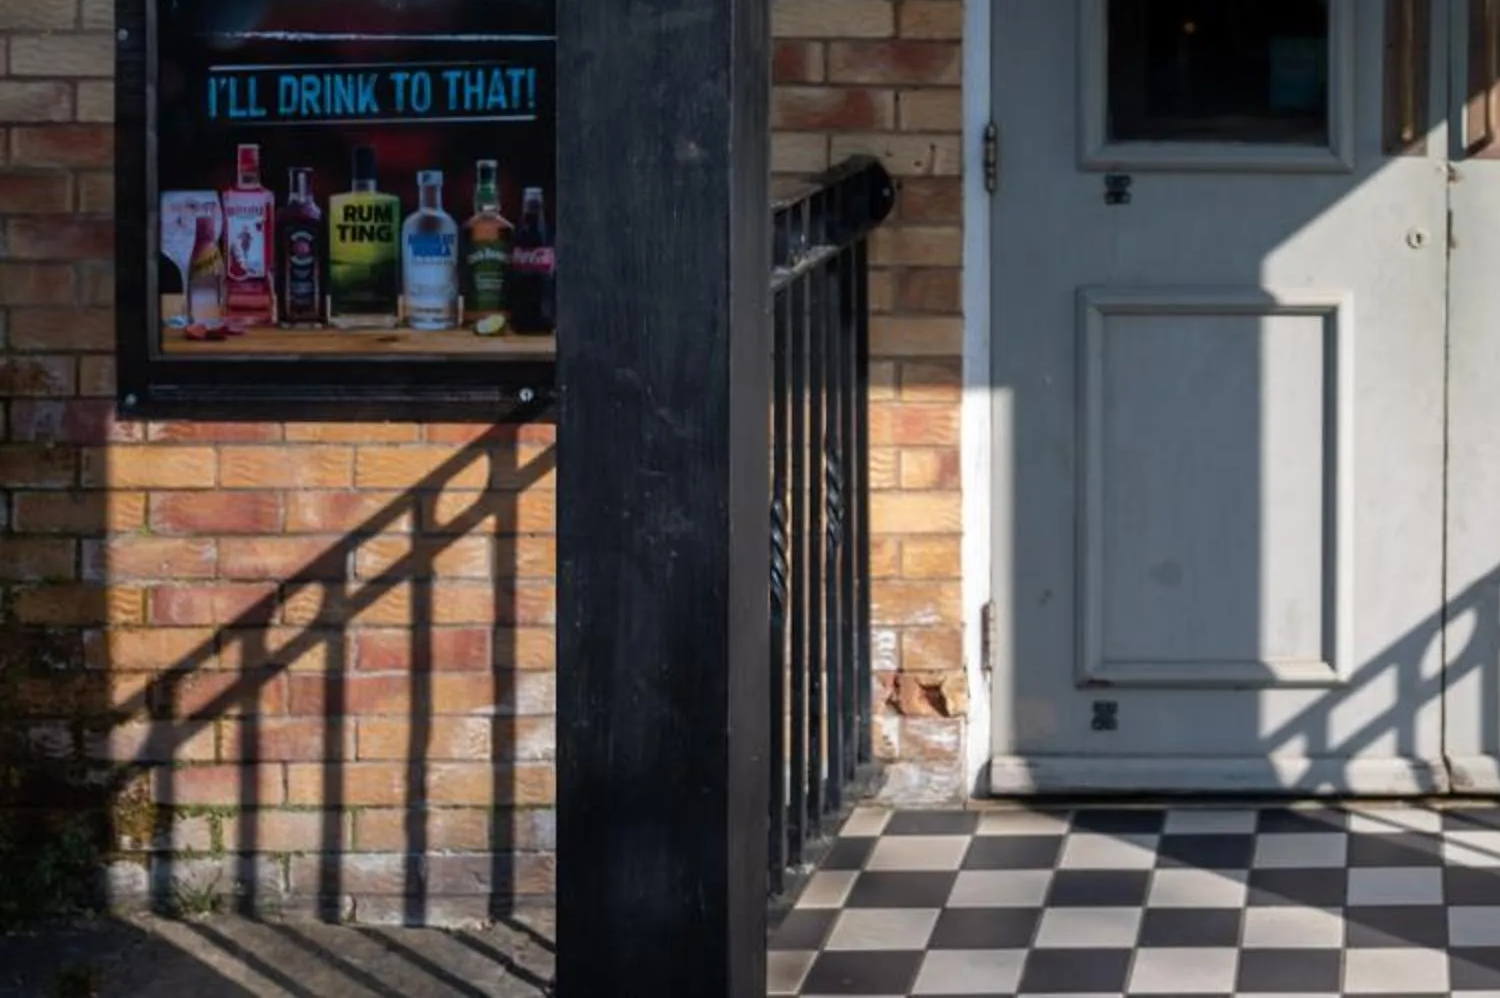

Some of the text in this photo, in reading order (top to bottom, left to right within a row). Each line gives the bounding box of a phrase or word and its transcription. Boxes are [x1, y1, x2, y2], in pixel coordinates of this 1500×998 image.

[207, 67, 537, 121] I'LL DRINK TO THAT!
[342, 204, 394, 224] RUM
[336, 224, 394, 244] TING
